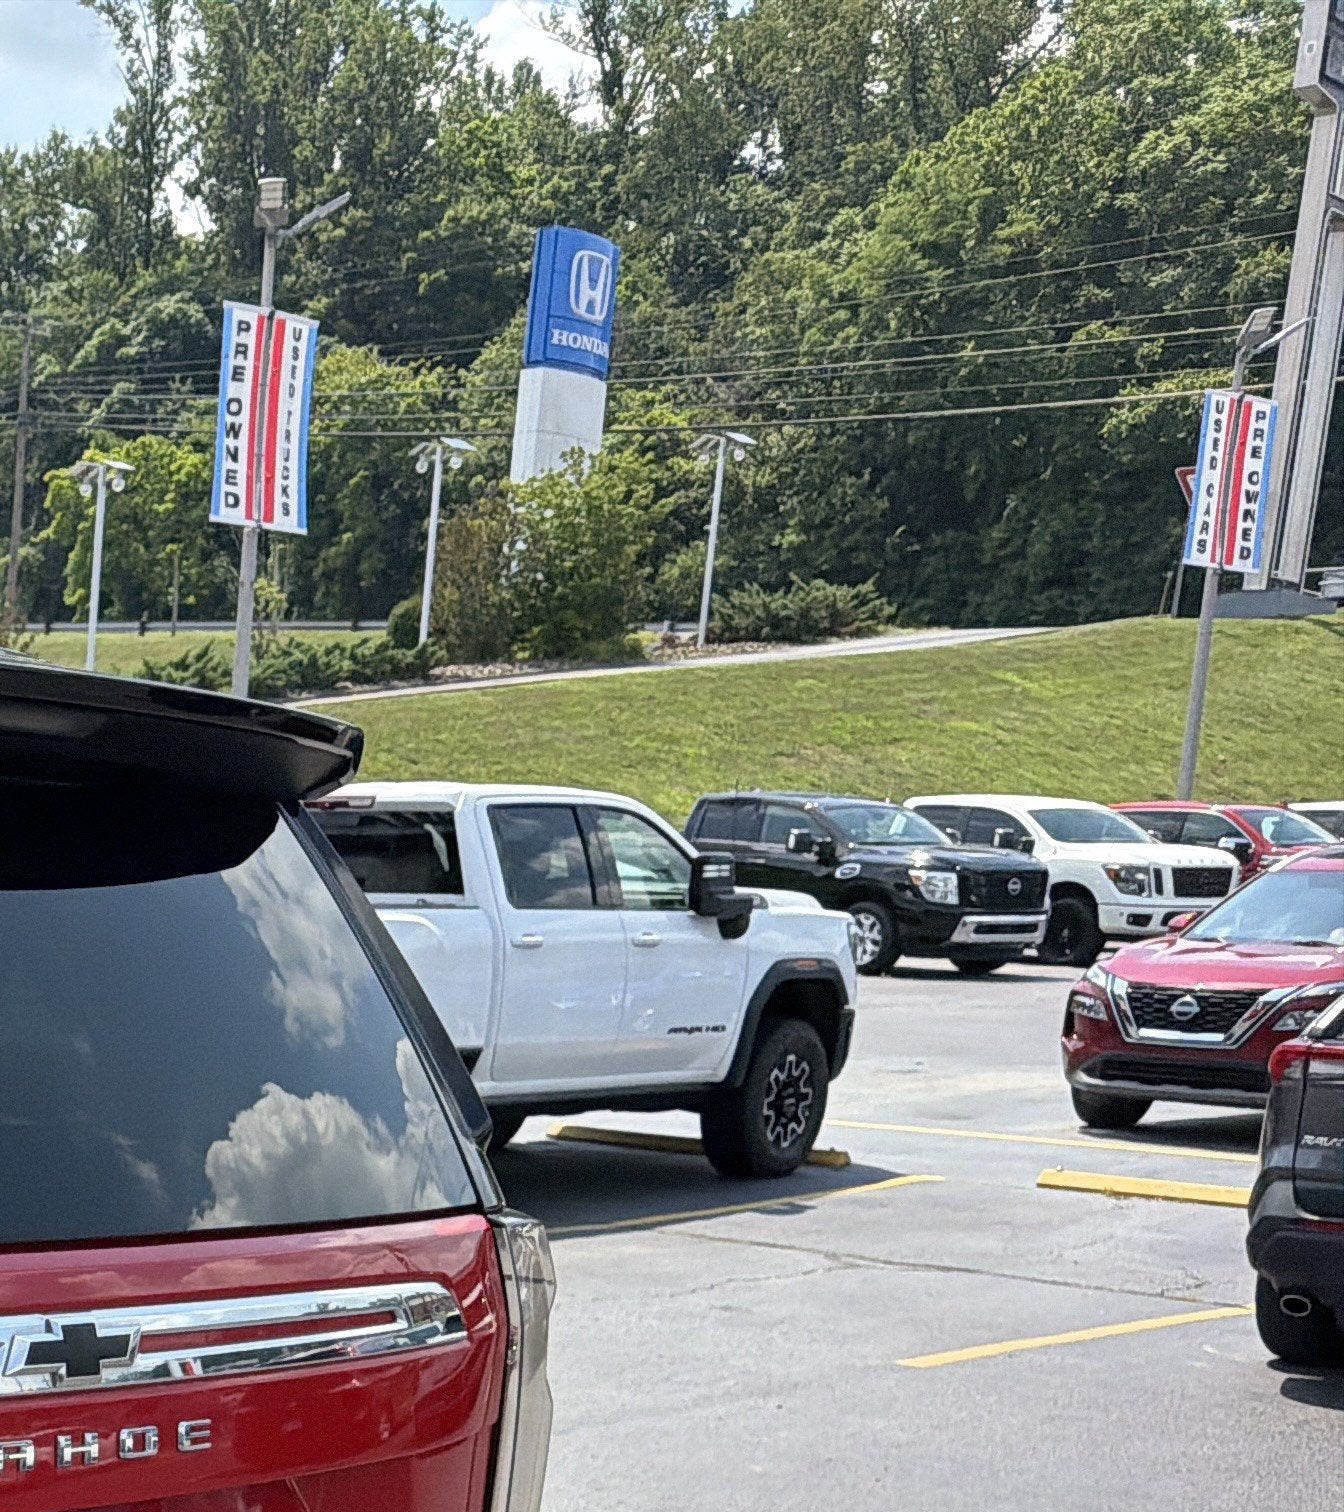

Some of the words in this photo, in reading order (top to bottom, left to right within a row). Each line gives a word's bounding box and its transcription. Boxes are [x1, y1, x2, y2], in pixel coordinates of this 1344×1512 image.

[231, 320, 252, 383] PRE
[288, 326, 303, 399] USED
[223, 398, 243, 510] OWNED
[280, 410, 294, 518] TRUCKS
[1209, 400, 1226, 470] USED
[1250, 410, 1267, 460] PRE
[1196, 483, 1215, 555] CARS
[1238, 470, 1261, 561] OWNED
